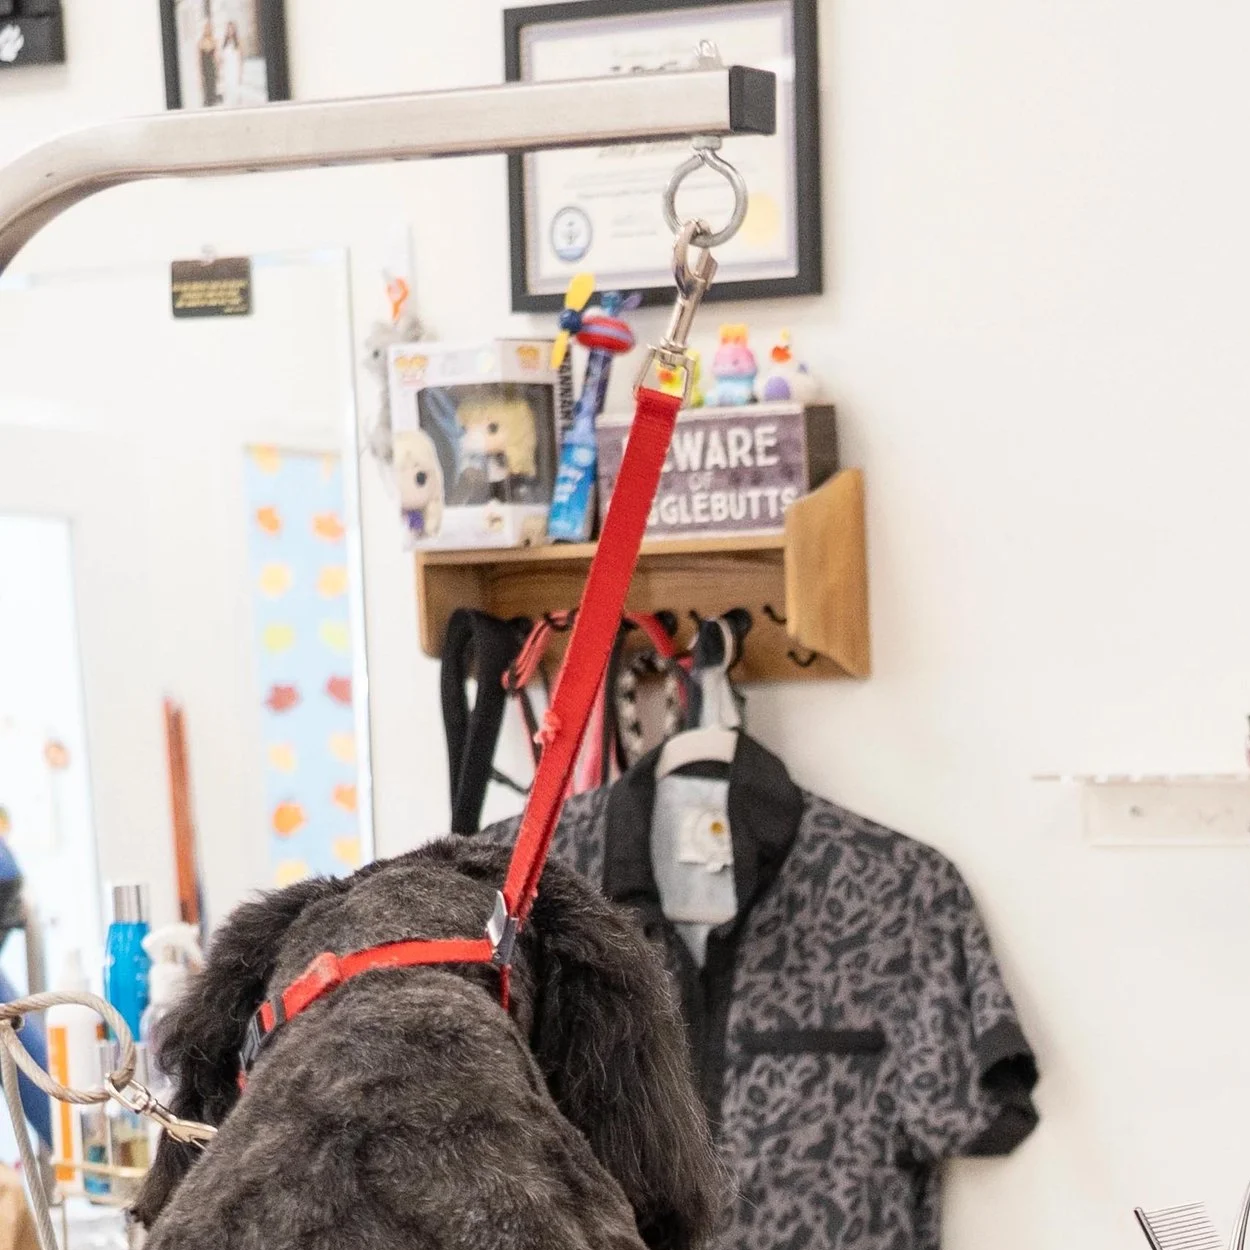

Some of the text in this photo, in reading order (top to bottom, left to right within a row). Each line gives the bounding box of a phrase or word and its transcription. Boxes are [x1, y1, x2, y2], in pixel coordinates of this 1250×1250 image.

[622, 424, 780, 473] WARE
[688, 471, 714, 491] OF
[606, 486, 798, 526] GLEBUTTS
